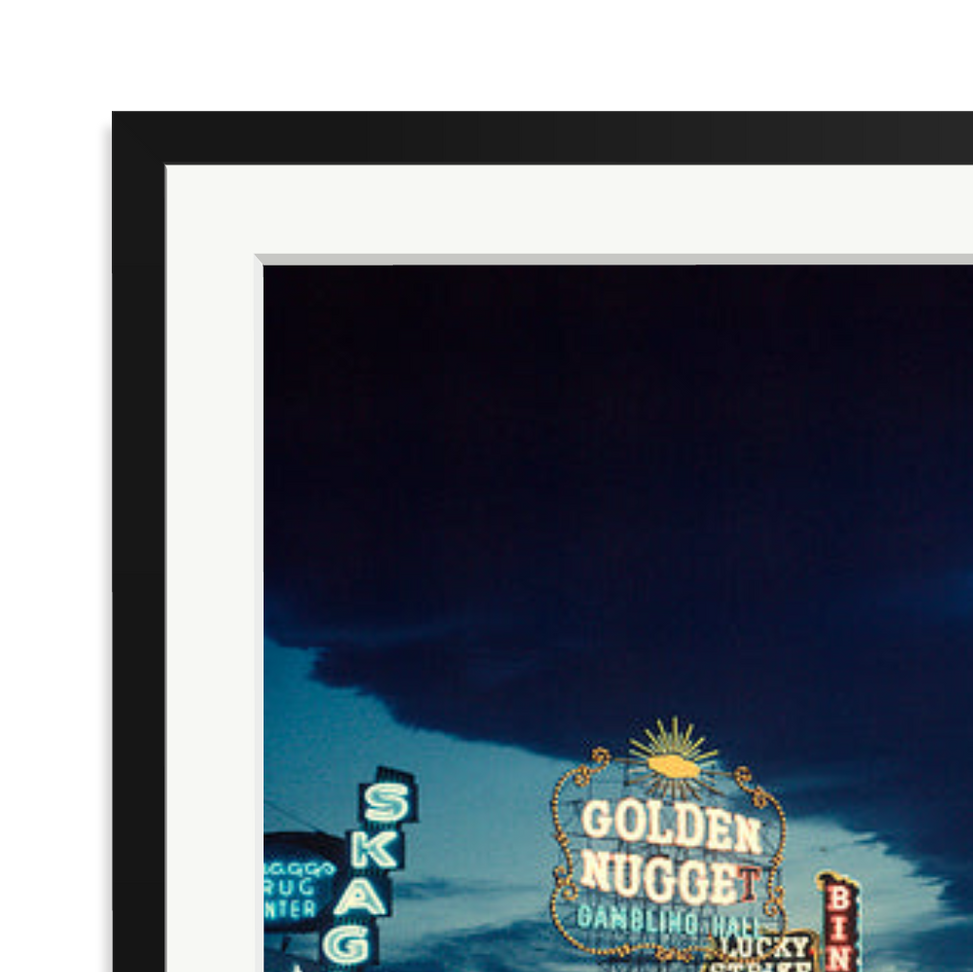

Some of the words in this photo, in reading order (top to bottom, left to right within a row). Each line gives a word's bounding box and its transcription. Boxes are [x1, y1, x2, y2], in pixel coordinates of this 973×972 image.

[581, 797, 763, 855] GOLDEN
[264, 877, 316, 896] RUG
[580, 849, 762, 906] NUGGET
[264, 899, 317, 919] NTER
[577, 903, 699, 936] GAMBLING
[712, 914, 761, 939] HALL
[720, 936, 810, 958] LUCKY
